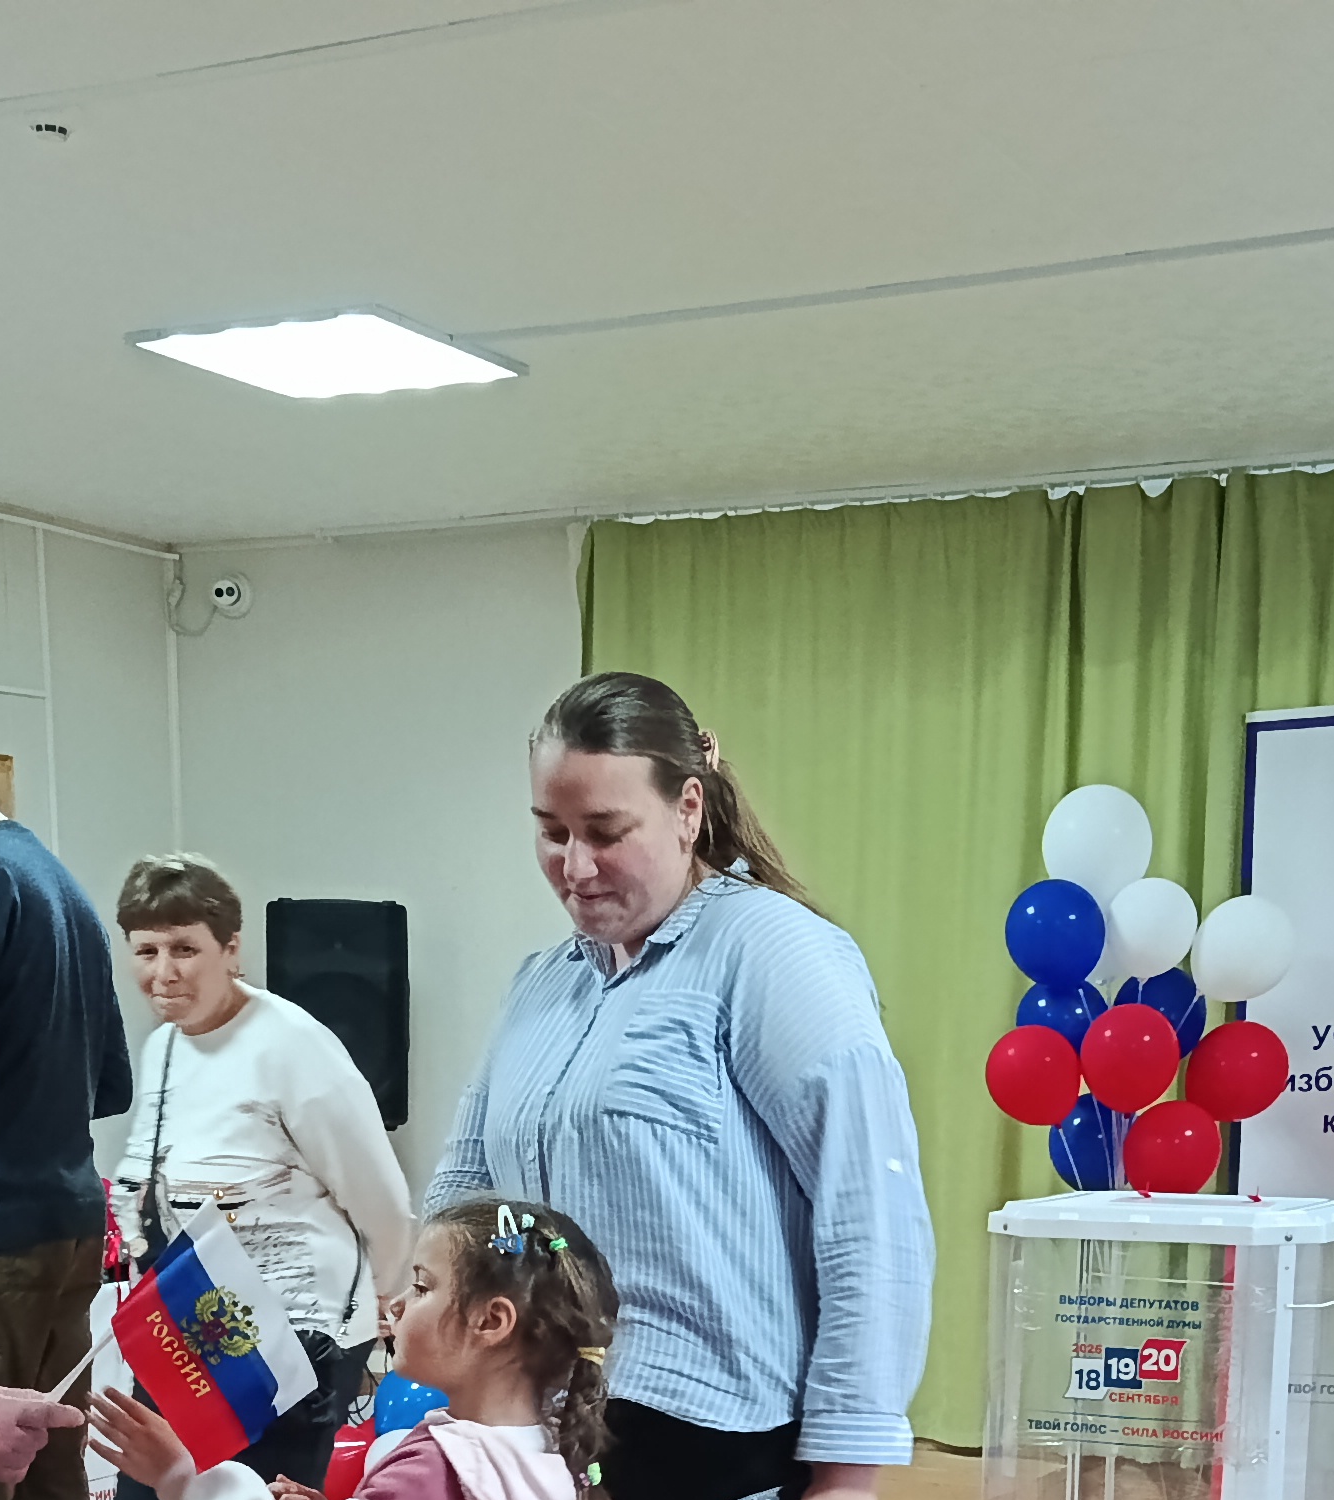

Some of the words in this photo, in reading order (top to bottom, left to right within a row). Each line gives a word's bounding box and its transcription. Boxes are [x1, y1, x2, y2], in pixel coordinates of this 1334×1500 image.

[1058, 1294, 1117, 1307] ВЫБОРЫ
[1119, 1297, 1200, 1311] ДЕПУТАТОВ
[1054, 1313, 1164, 1328] ГОСУДАРСТВЕННОЙ
[1166, 1319, 1202, 1330] ДУМЫ
[145, 1310, 211, 1398] РОССИЯ
[1072, 1343, 1102, 1354] 2026
[1107, 1357, 1136, 1381] 19
[1141, 1348, 1177, 1372] 20
[1074, 1368, 1101, 1391] 18
[1109, 1391, 1179, 1406] СЕНТЯБРЯ
[1028, 1417, 1061, 1431] ТВОЙ
[1063, 1421, 1107, 1435] ГОЛОС
[1121, 1426, 1159, 1439] СИЛА
